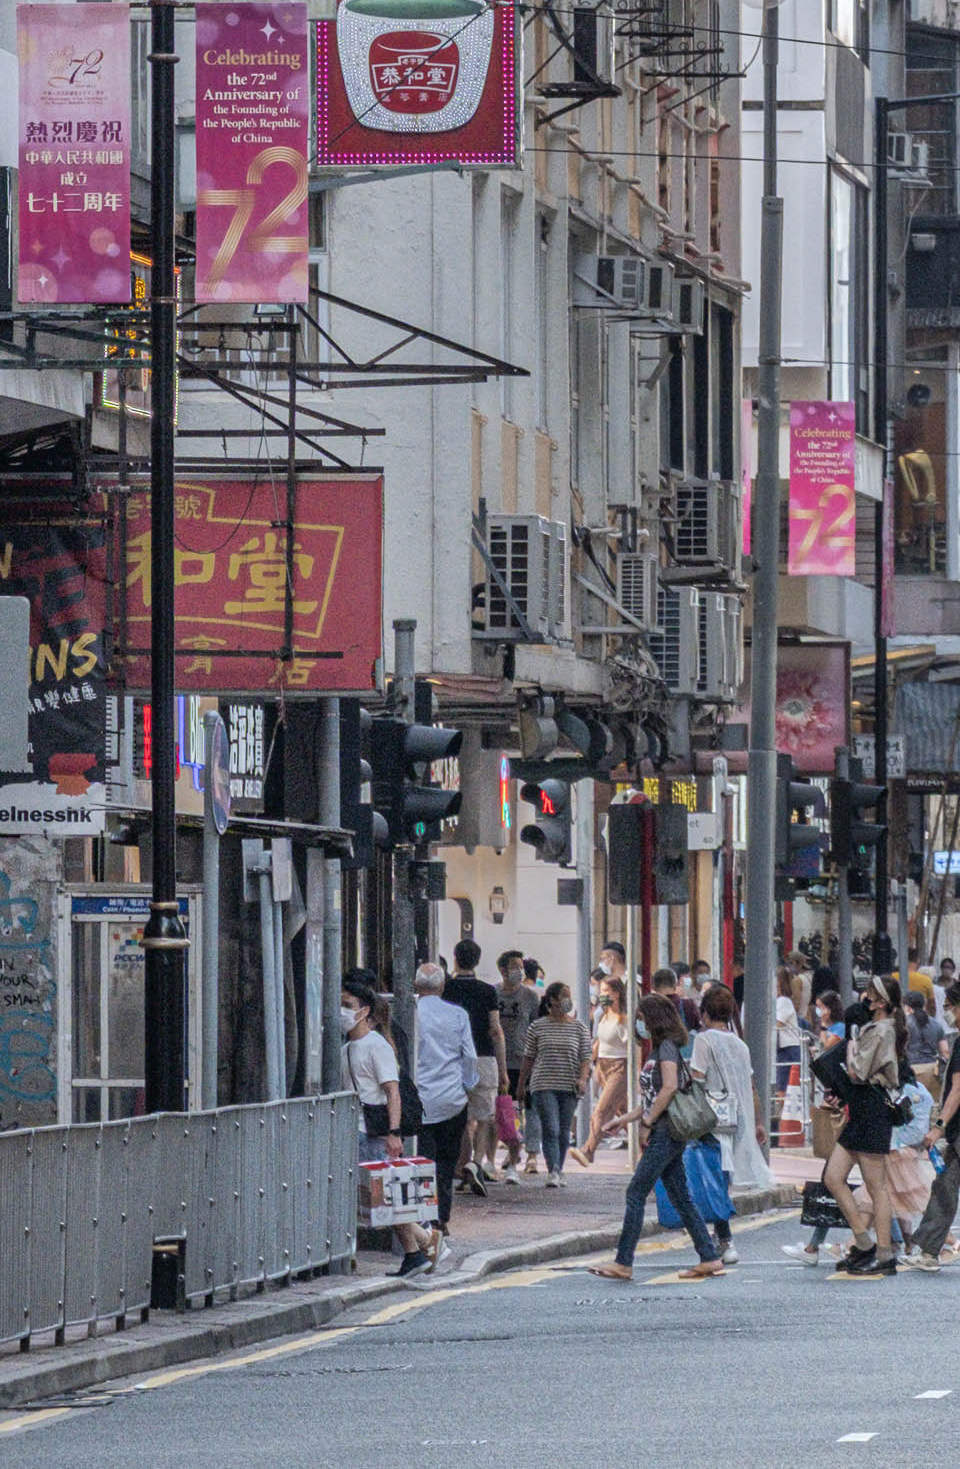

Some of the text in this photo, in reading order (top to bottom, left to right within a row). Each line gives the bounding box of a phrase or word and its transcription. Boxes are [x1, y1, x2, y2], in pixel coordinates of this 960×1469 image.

[203, 48, 302, 70] Celebrating
[227, 71, 277, 86] the 72nd
[380, 67, 447, 85] 恭和堂
[203, 87, 302, 104] Anniversary of
[213, 104, 290, 116] the Founding of
[26, 120, 124, 144] 熱烈慶祝
[203, 118, 301, 130] the People's Republic
[231, 133, 273, 143] of China
[25, 150, 123, 166] 中華人民共和國
[60, 171, 88, 187] 成立
[26, 191, 124, 213] 七十二周年
[196, 146, 308, 296] 72
[795, 428, 851, 441] Celebrating
[790, 484, 855, 561] 72
